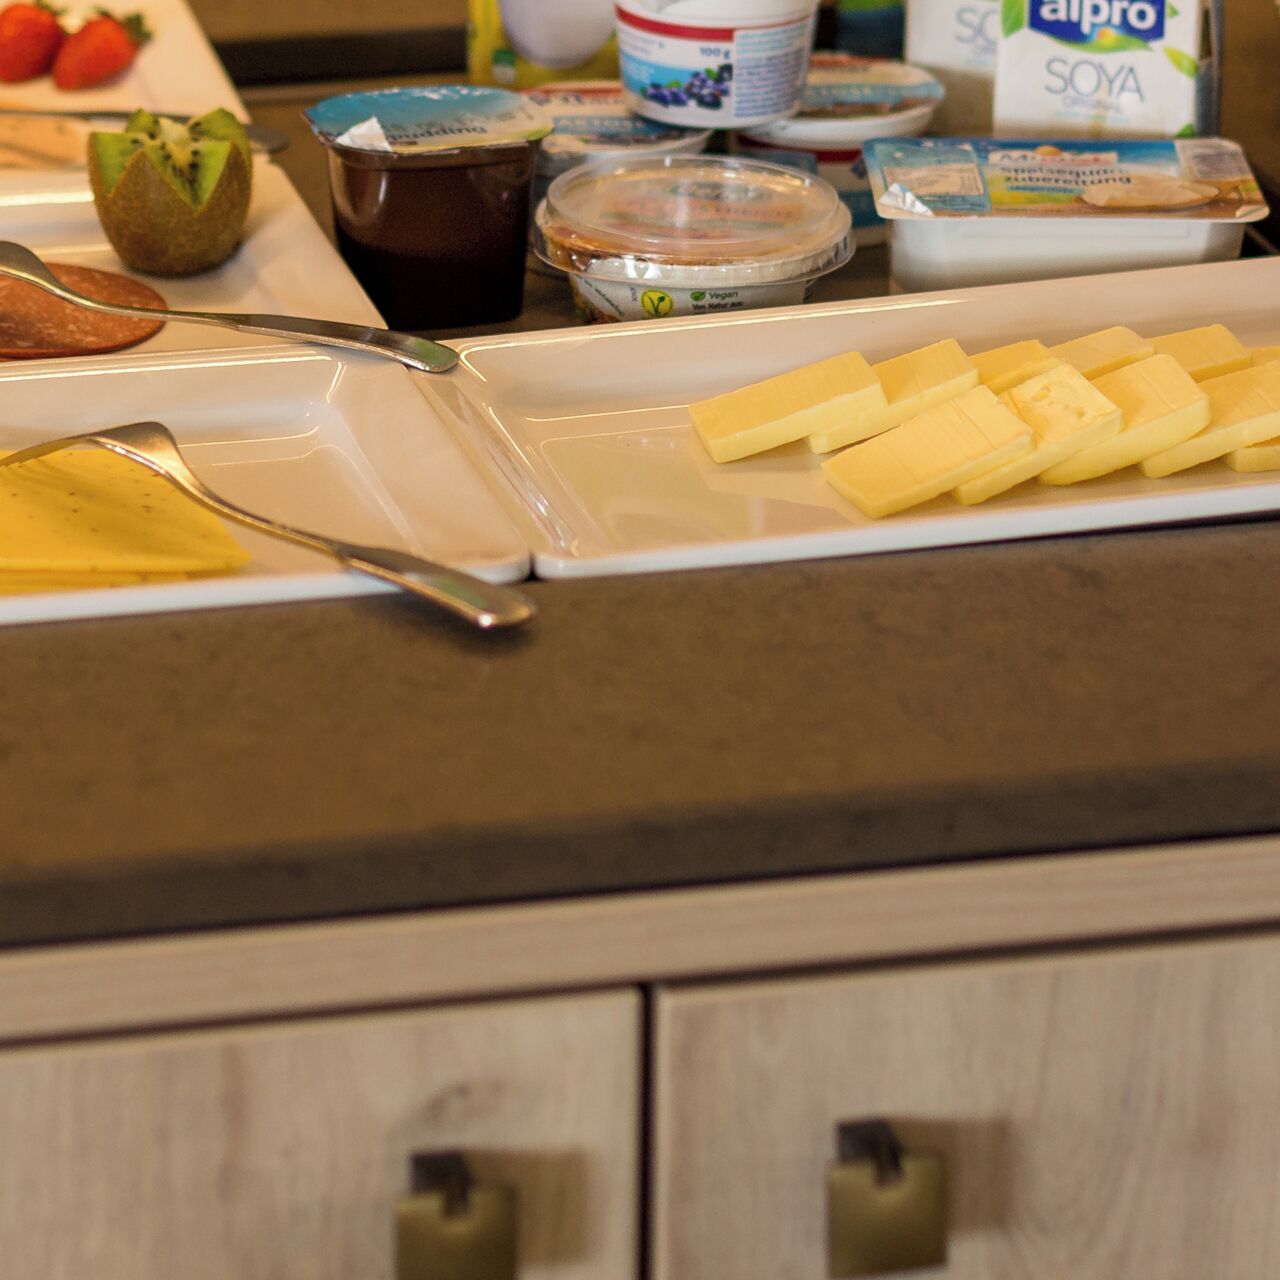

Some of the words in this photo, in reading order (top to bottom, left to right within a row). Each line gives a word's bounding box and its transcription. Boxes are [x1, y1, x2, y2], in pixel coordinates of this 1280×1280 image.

[699, 46, 720, 58] 100
[1044, 57, 1145, 103] SOYA
[709, 290, 739, 301] Vegan
